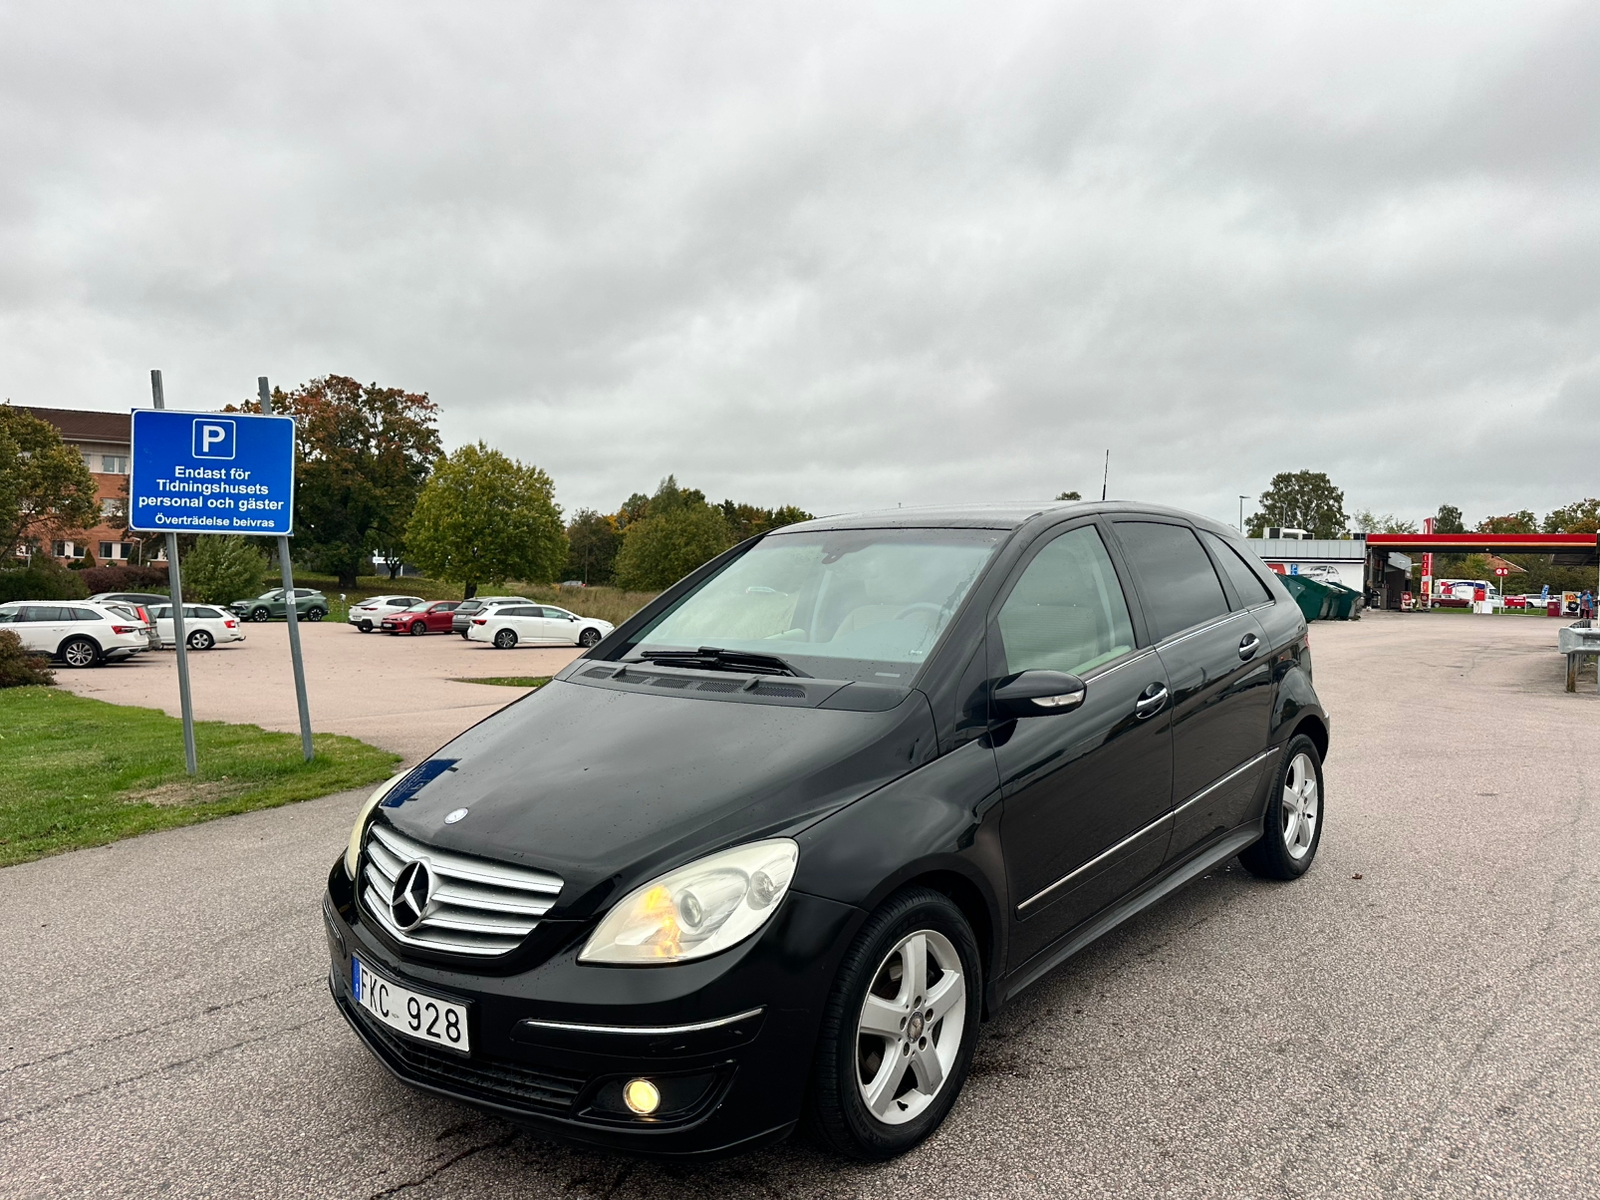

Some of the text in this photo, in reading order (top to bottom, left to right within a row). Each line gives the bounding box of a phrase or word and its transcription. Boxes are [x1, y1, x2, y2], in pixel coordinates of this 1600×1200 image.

[203, 425, 226, 452] P
[175, 466, 251, 480] Endast för
[156, 479, 269, 495] Tidningshusets
[138, 496, 284, 511] personal och gäster
[155, 513, 275, 527] Överträdelse beivras
[362, 967, 461, 1043] FKC 928
